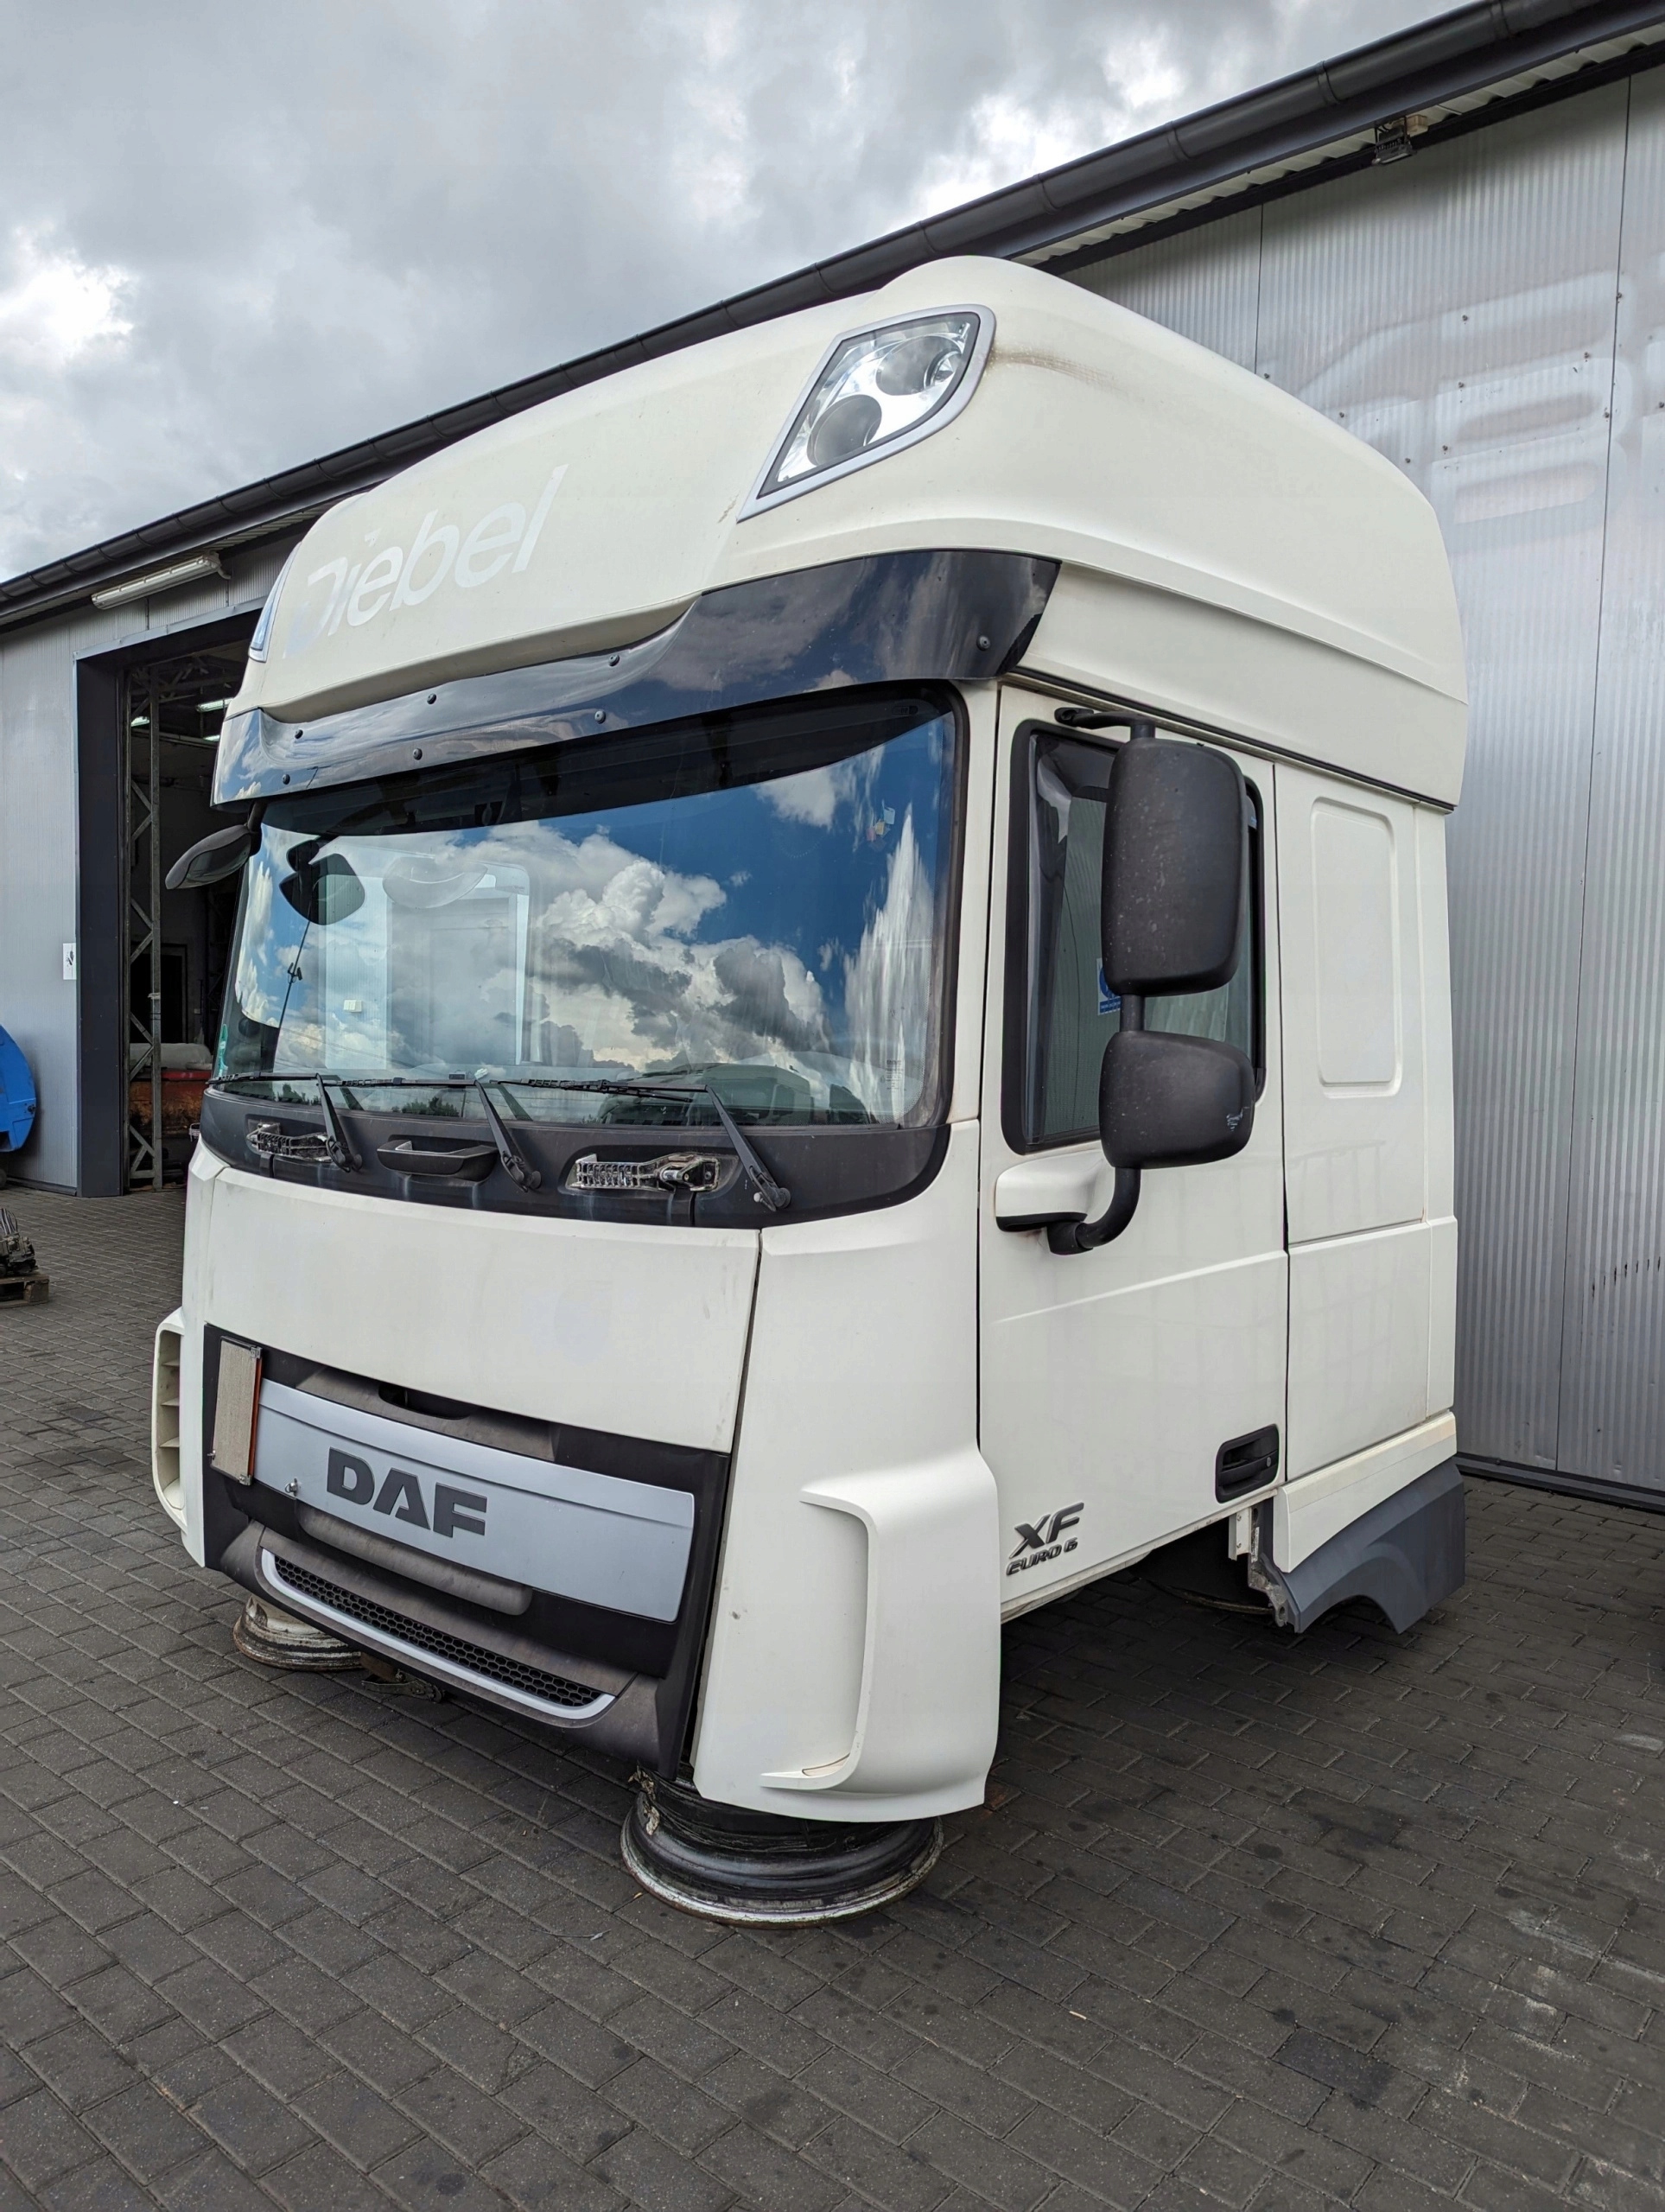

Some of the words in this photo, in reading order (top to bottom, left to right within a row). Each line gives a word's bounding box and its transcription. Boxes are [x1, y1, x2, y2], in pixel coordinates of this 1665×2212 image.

[327, 1446, 487, 1538] DAF
[1007, 1544, 1063, 1575] EURO
[1064, 1537, 1078, 1554] 6
[1009, 1502, 1084, 1558] XF
